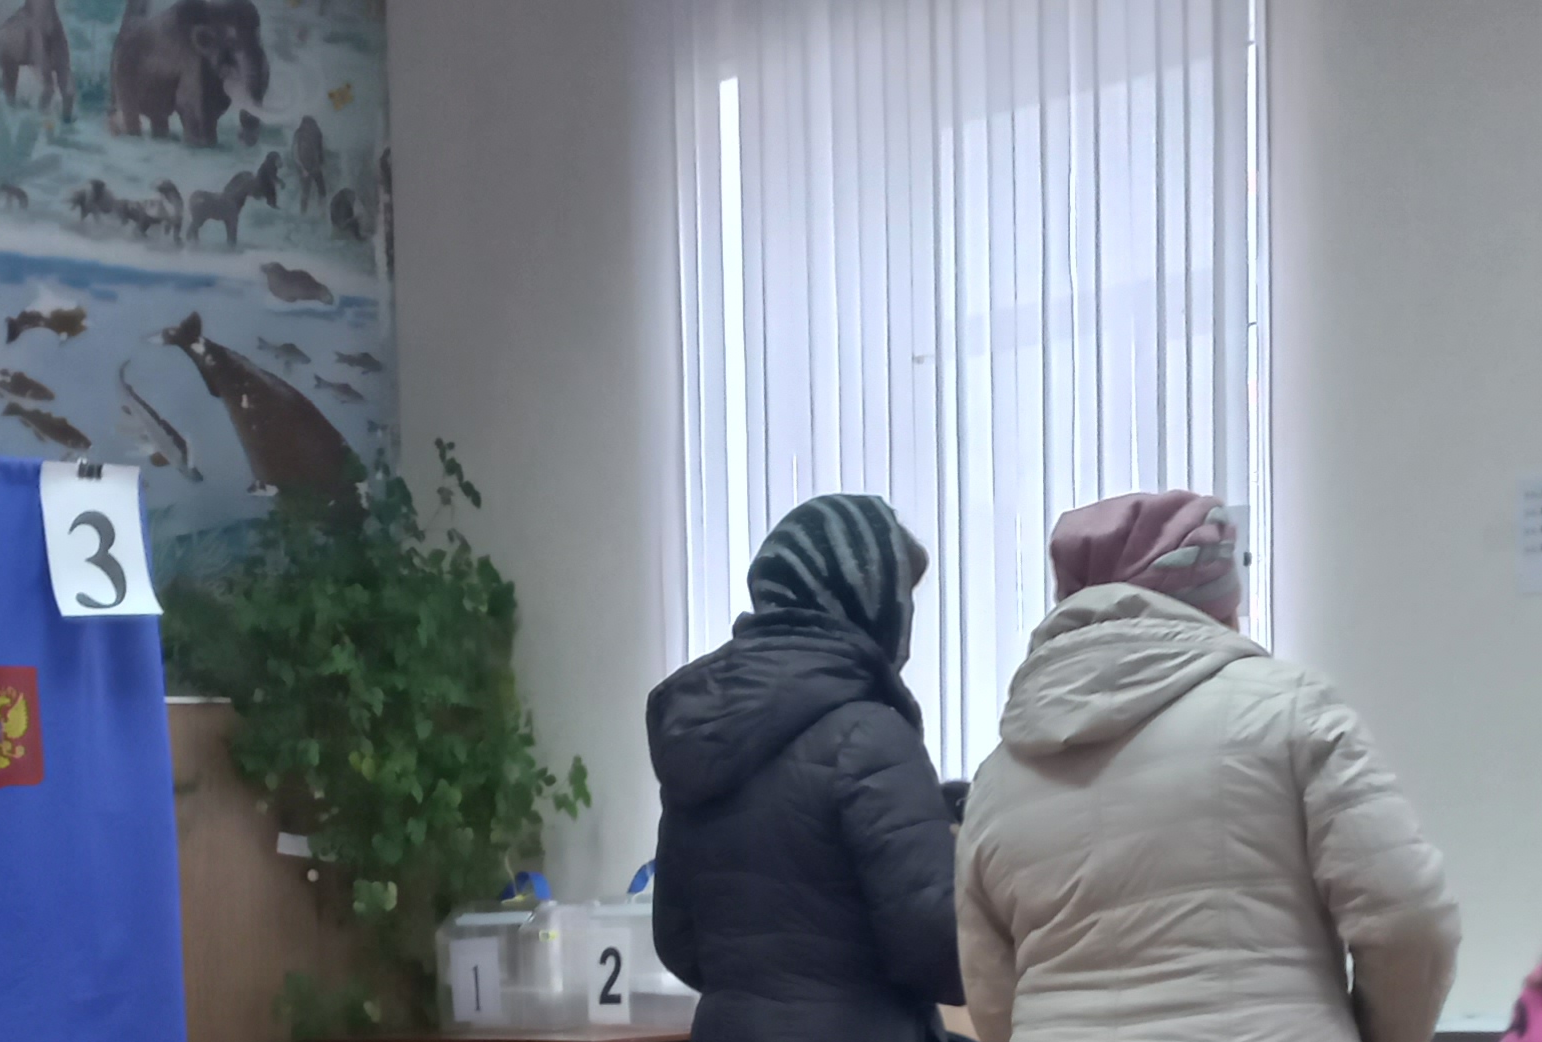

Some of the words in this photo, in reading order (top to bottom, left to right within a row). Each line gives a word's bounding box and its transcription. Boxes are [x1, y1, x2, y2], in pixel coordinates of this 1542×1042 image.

[67, 509, 128, 610] 3
[472, 964, 482, 1012] 1
[598, 946, 623, 1006] 2
